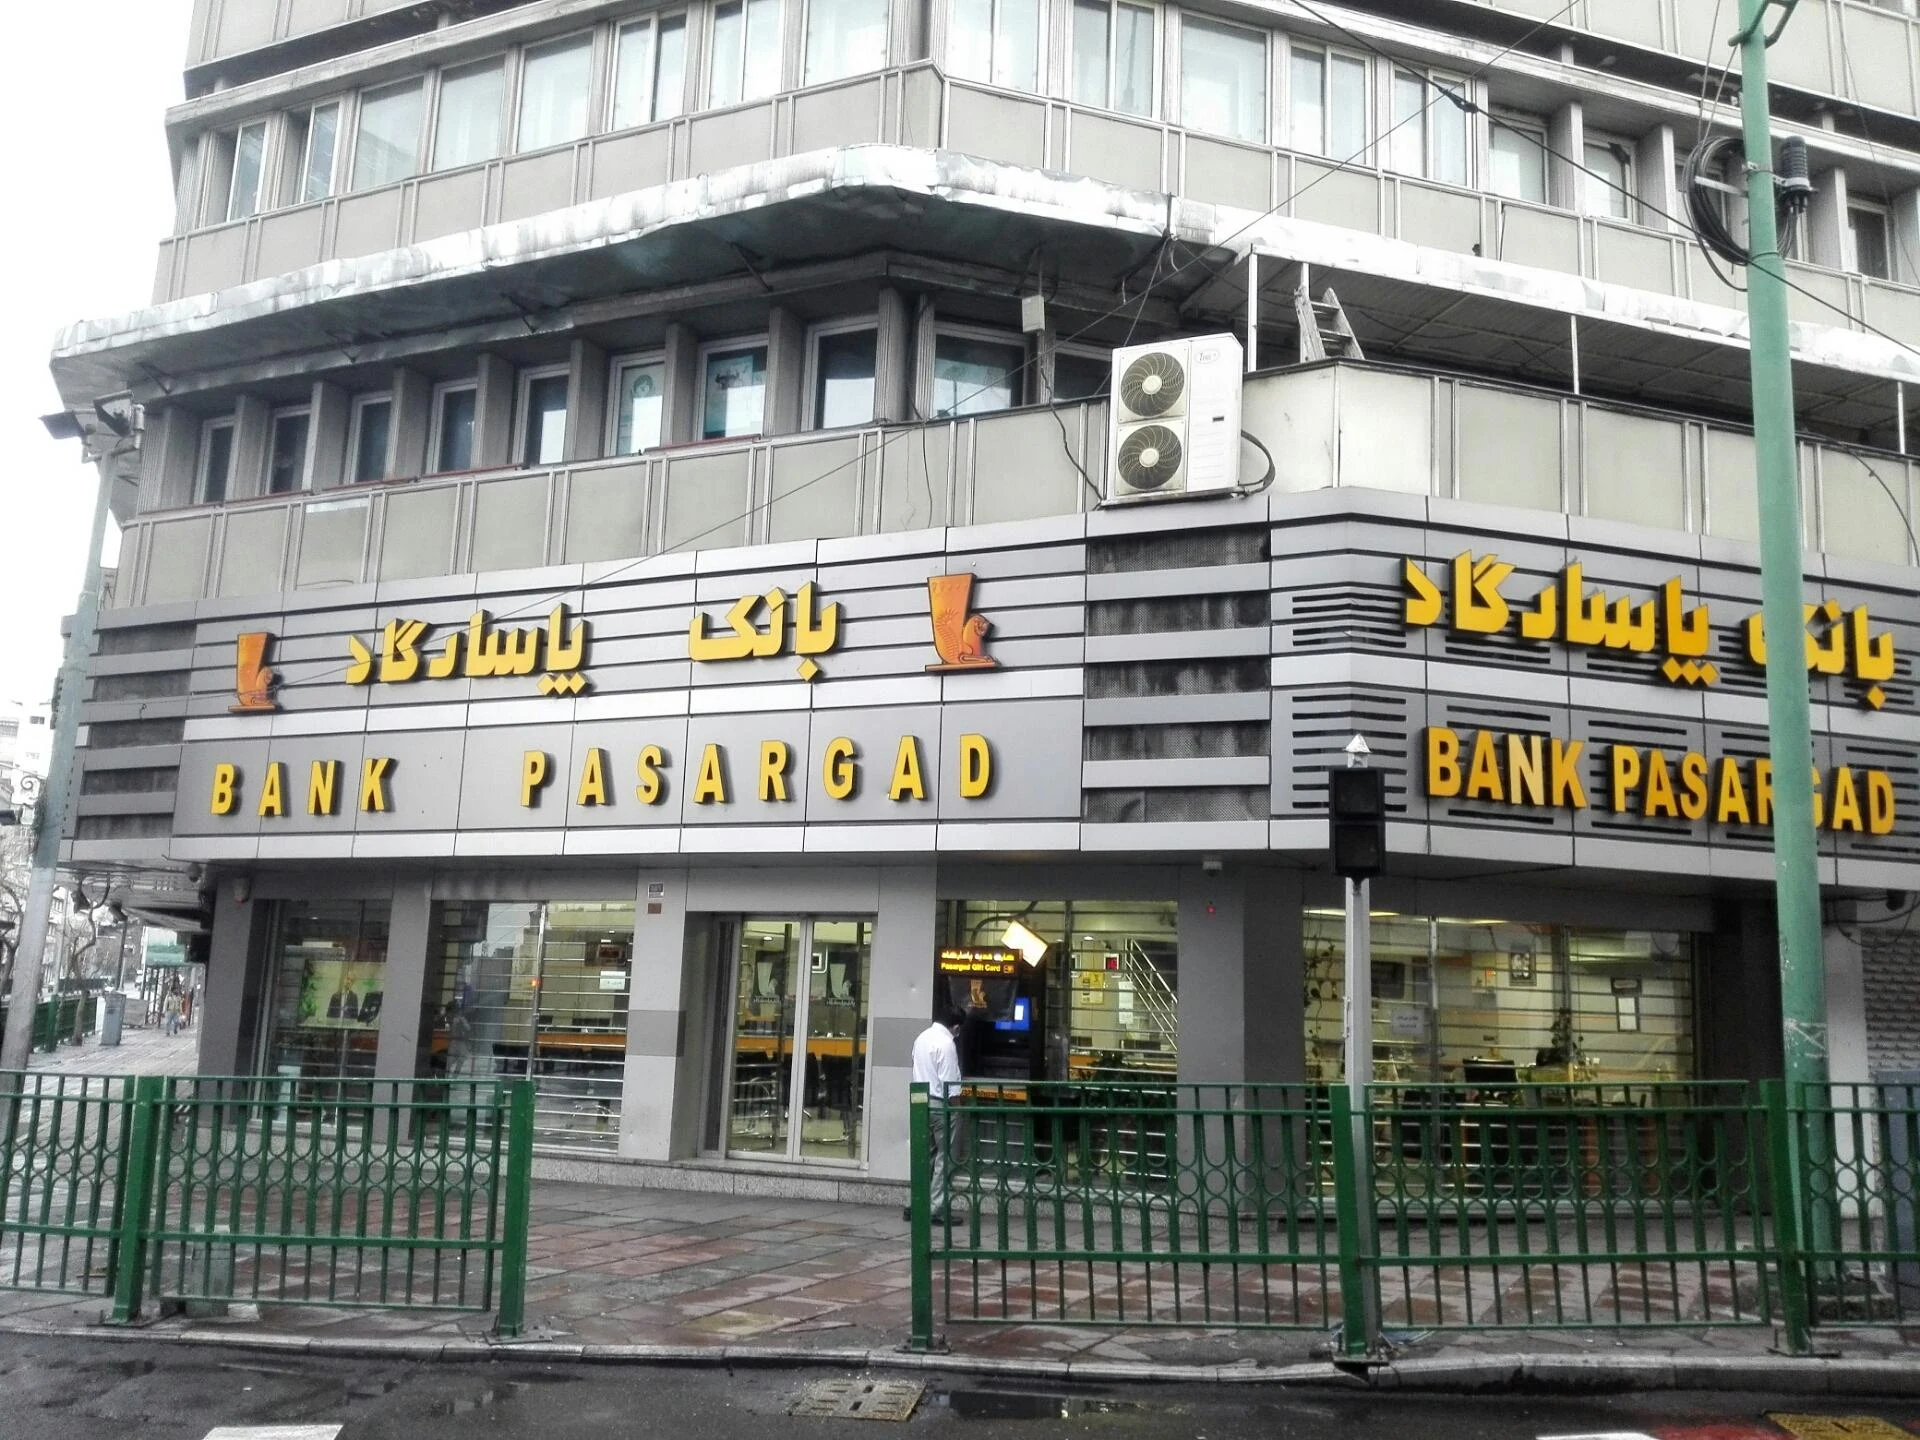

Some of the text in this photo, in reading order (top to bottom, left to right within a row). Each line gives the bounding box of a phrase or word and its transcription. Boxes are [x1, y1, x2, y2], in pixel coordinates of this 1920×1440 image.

[345, 580, 839, 695] بانک پاسارگاد
[1404, 549, 1720, 686] پاسارگاد
[211, 732, 993, 816] BANK PASARGAD
[1427, 726, 1588, 809] BANK
